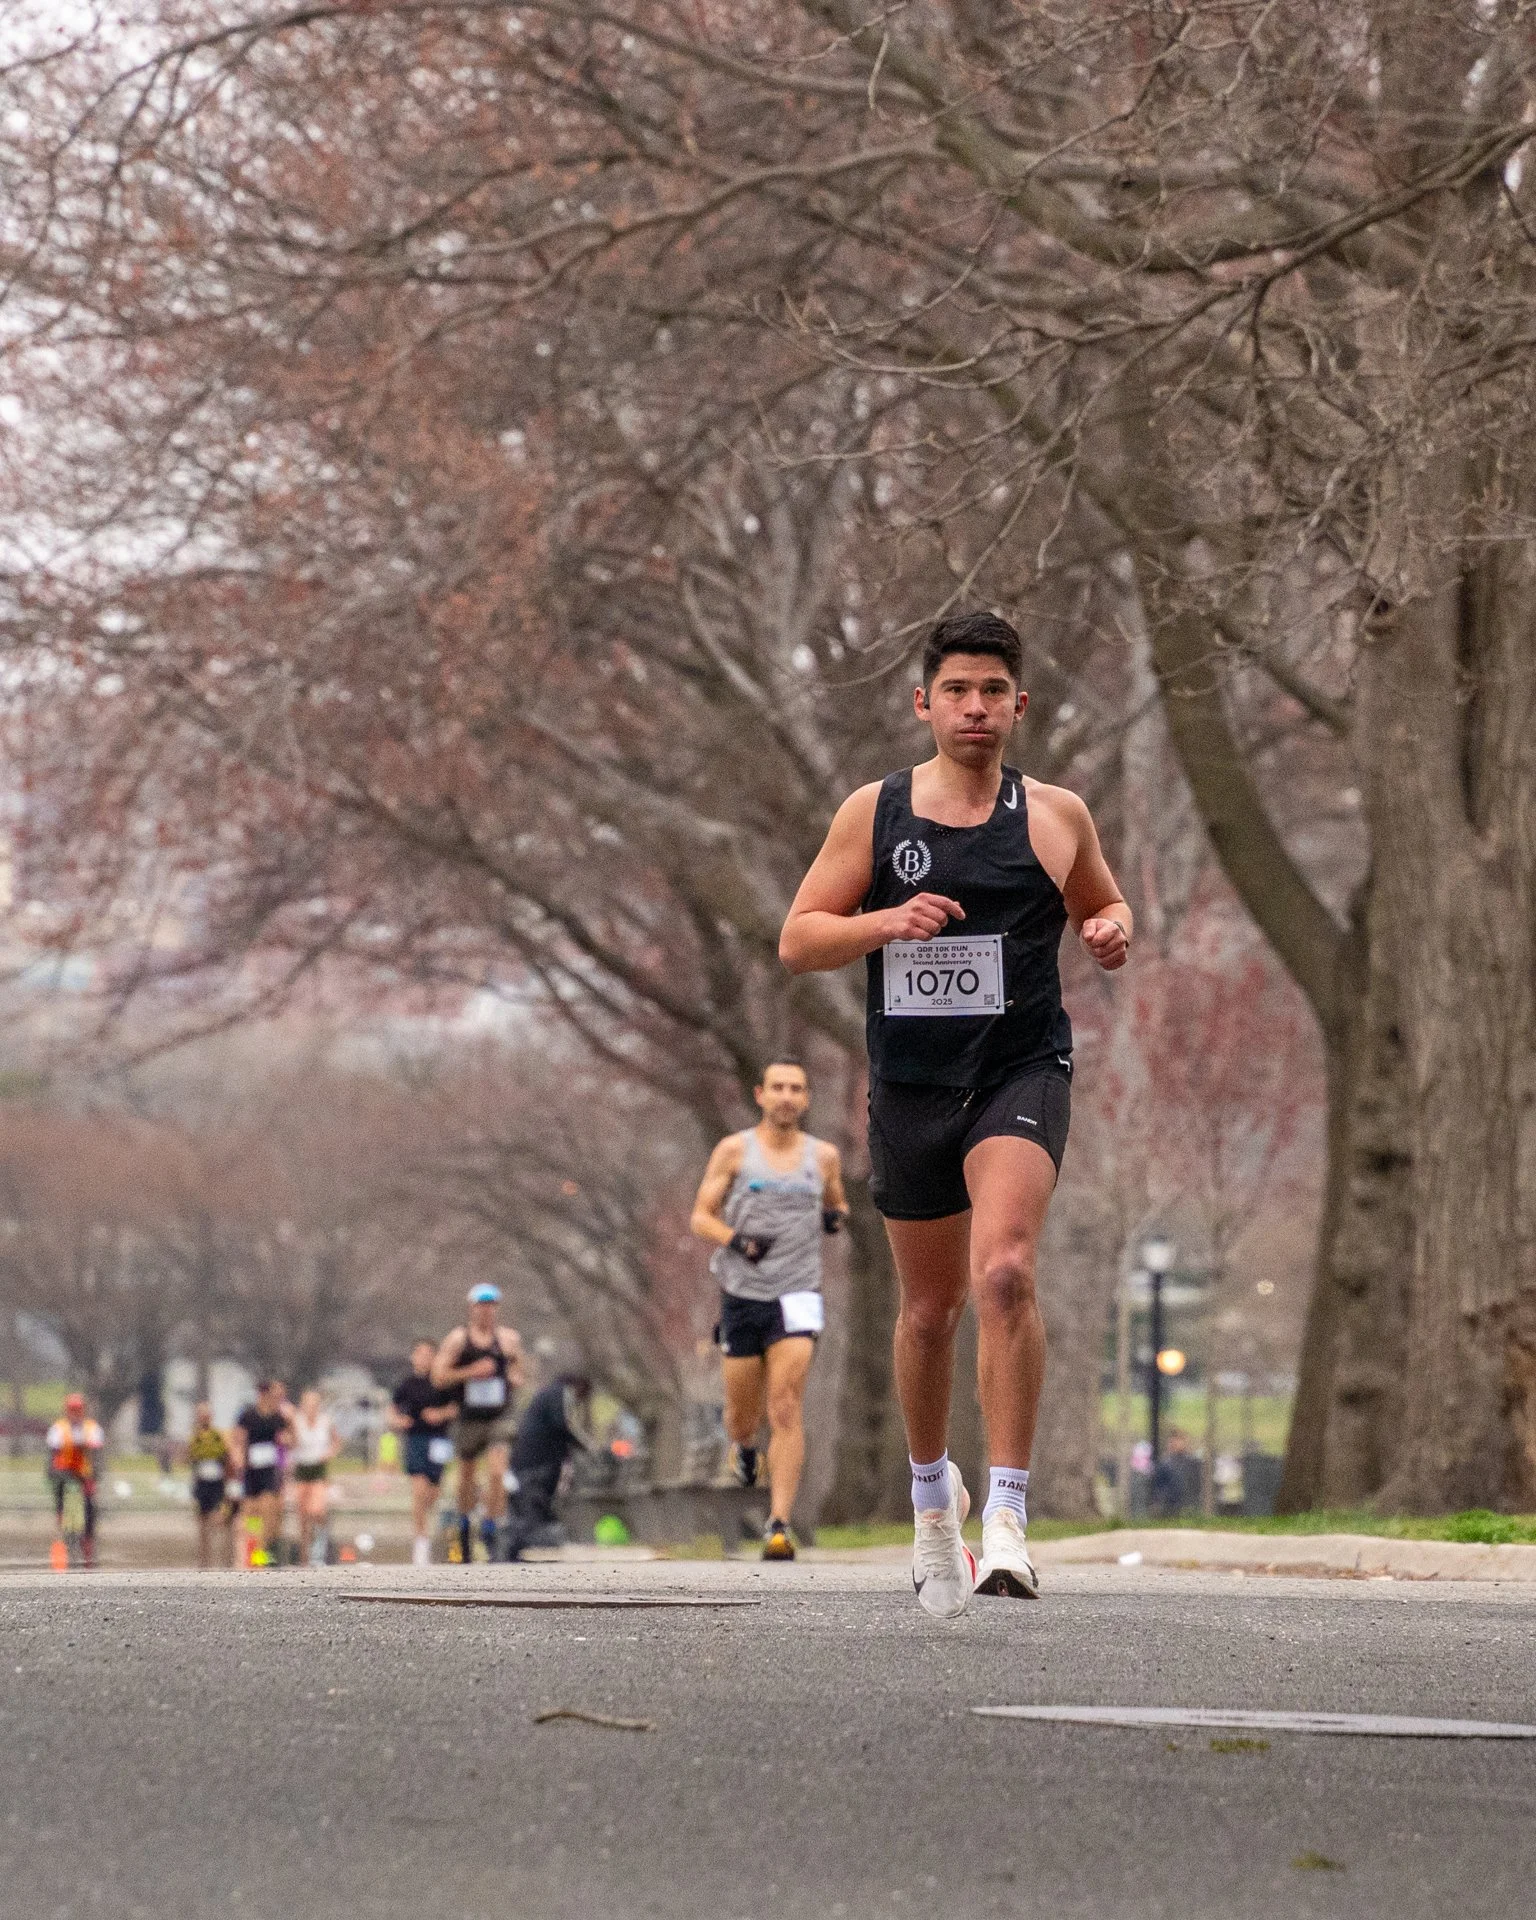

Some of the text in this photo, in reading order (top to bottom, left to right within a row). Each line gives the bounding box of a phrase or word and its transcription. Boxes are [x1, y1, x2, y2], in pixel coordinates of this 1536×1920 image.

[904, 850, 920, 872] B
[905, 968, 980, 996] 1070
[931, 998, 953, 1006] 2025
